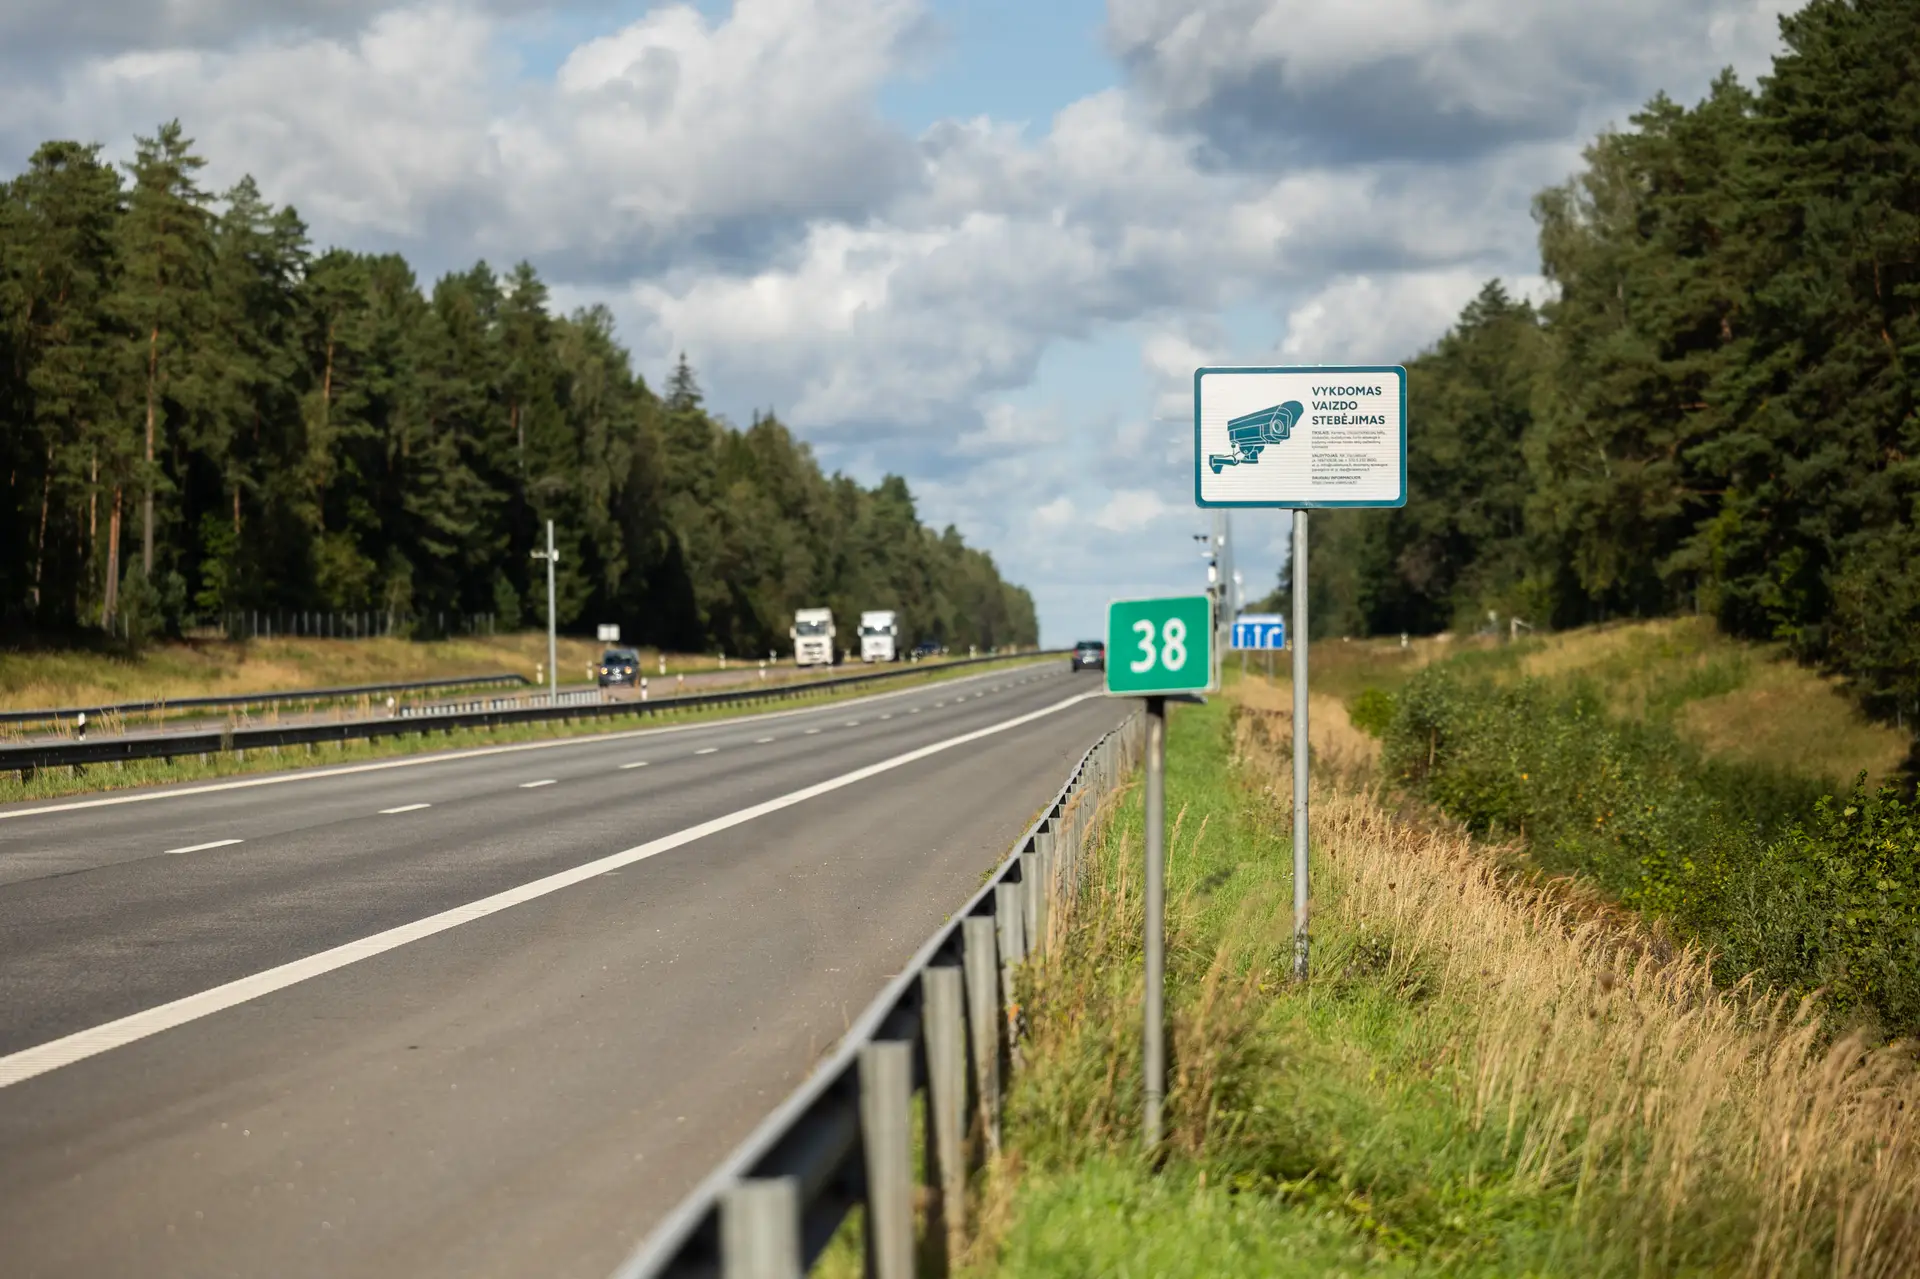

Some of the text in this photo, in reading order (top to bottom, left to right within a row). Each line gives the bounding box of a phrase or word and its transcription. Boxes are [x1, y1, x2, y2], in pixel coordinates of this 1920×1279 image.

[1311, 386, 1382, 396] VYKDOMAS
[1311, 401, 1358, 411] VAIZDO
[1311, 413, 1386, 425] STEBĖJIMAS
[1130, 617, 1187, 673] 38
